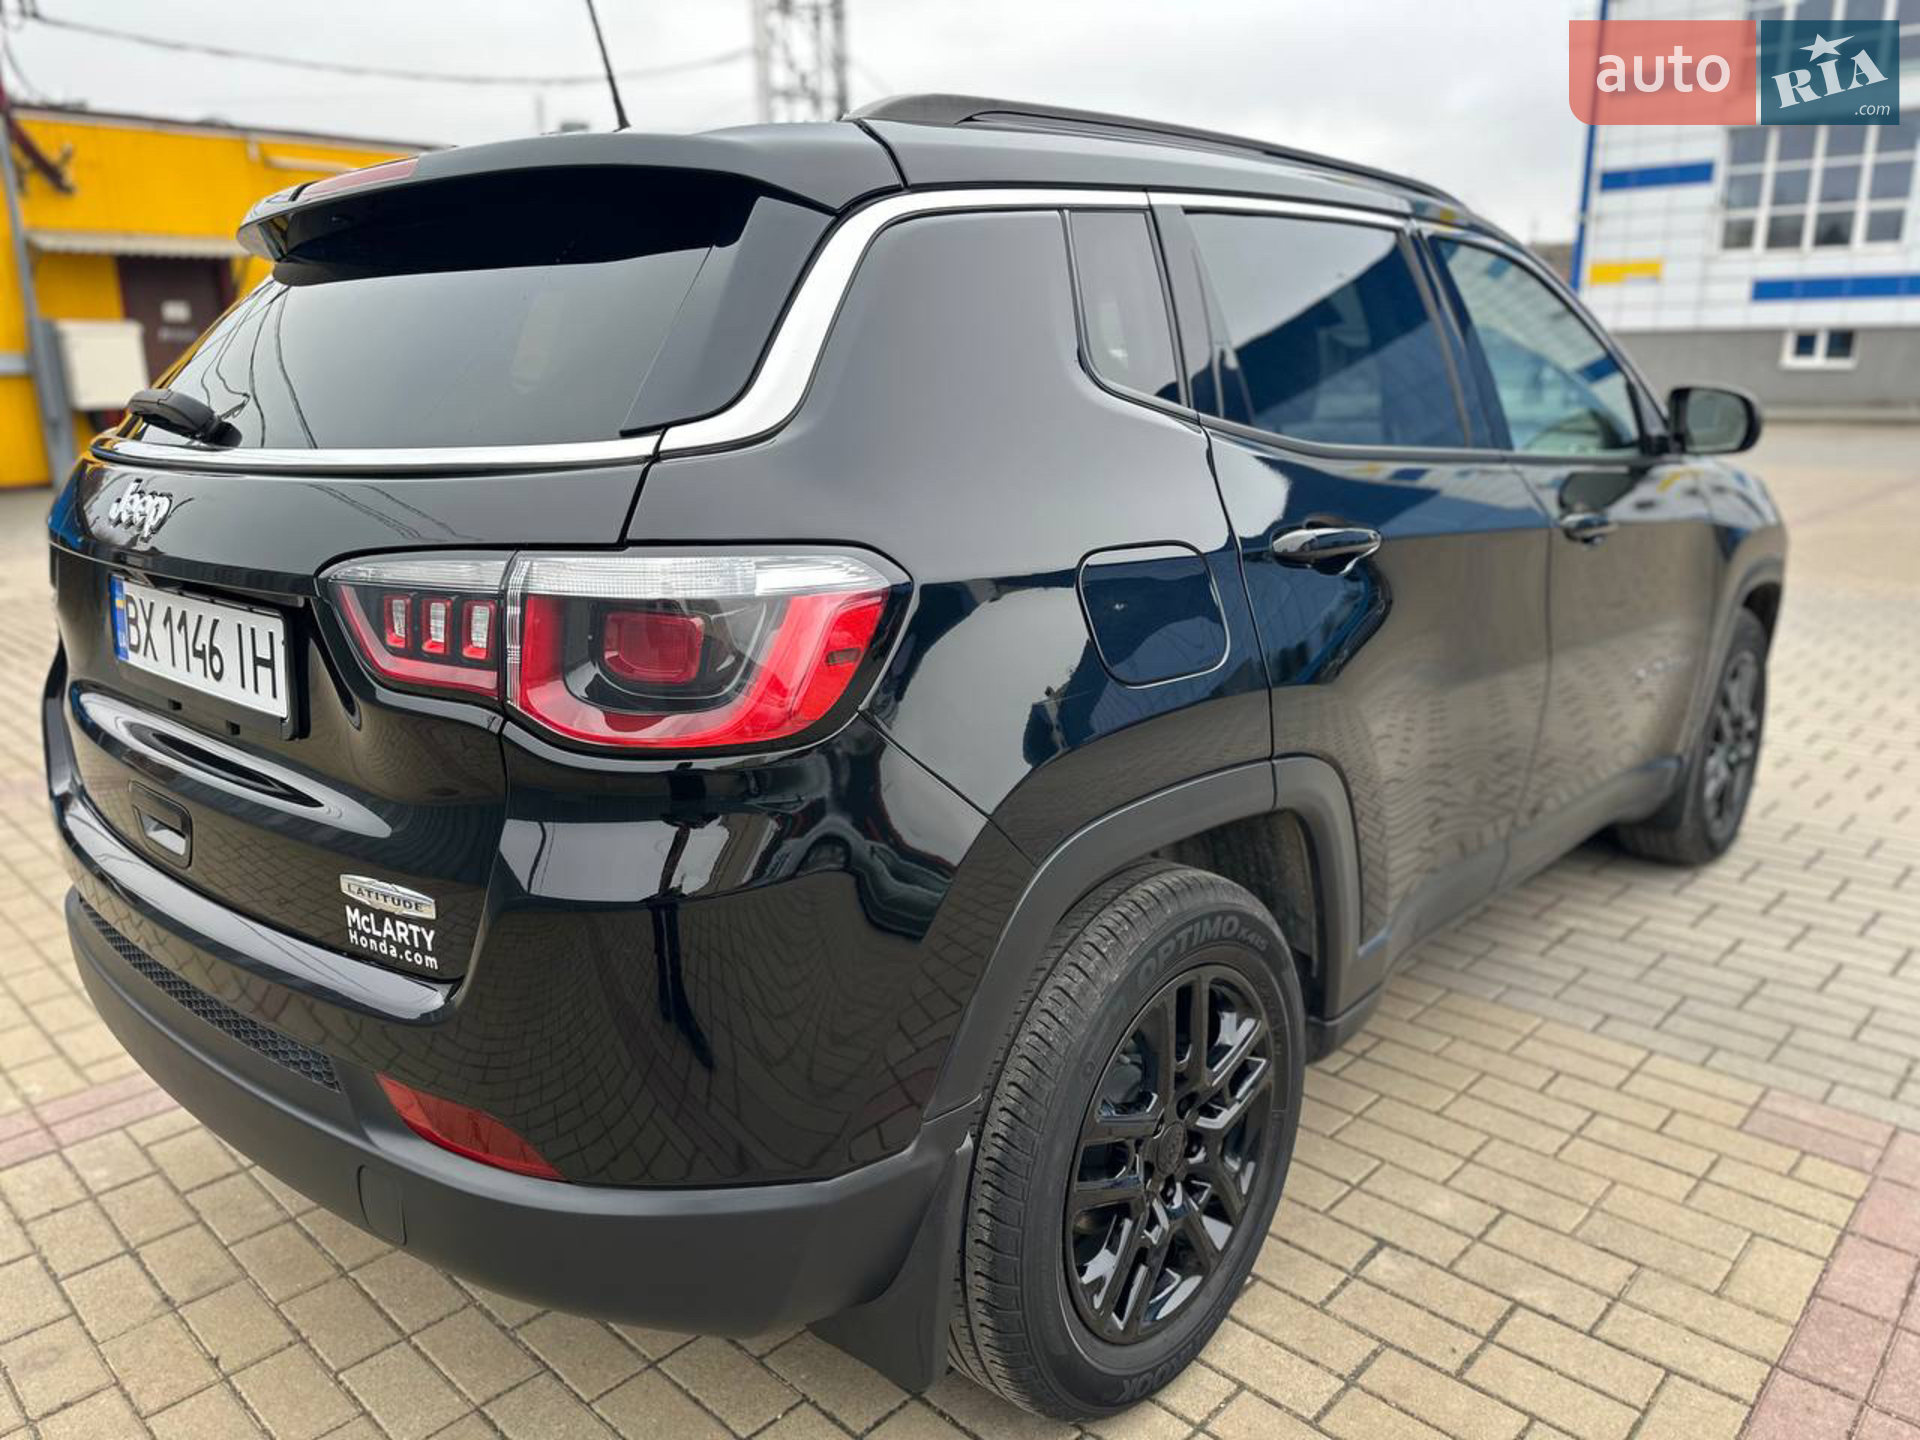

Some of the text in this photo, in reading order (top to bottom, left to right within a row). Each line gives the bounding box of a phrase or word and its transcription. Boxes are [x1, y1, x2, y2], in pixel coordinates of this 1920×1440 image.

[108, 478, 172, 541] Jeep
[125, 593, 278, 700] BX 1146 IH
[346, 882, 425, 914] LATITUDE
[345, 904, 436, 952] McLARTY
[348, 928, 439, 970] Honda.com
[1137, 914, 1241, 987] OPTIMO
